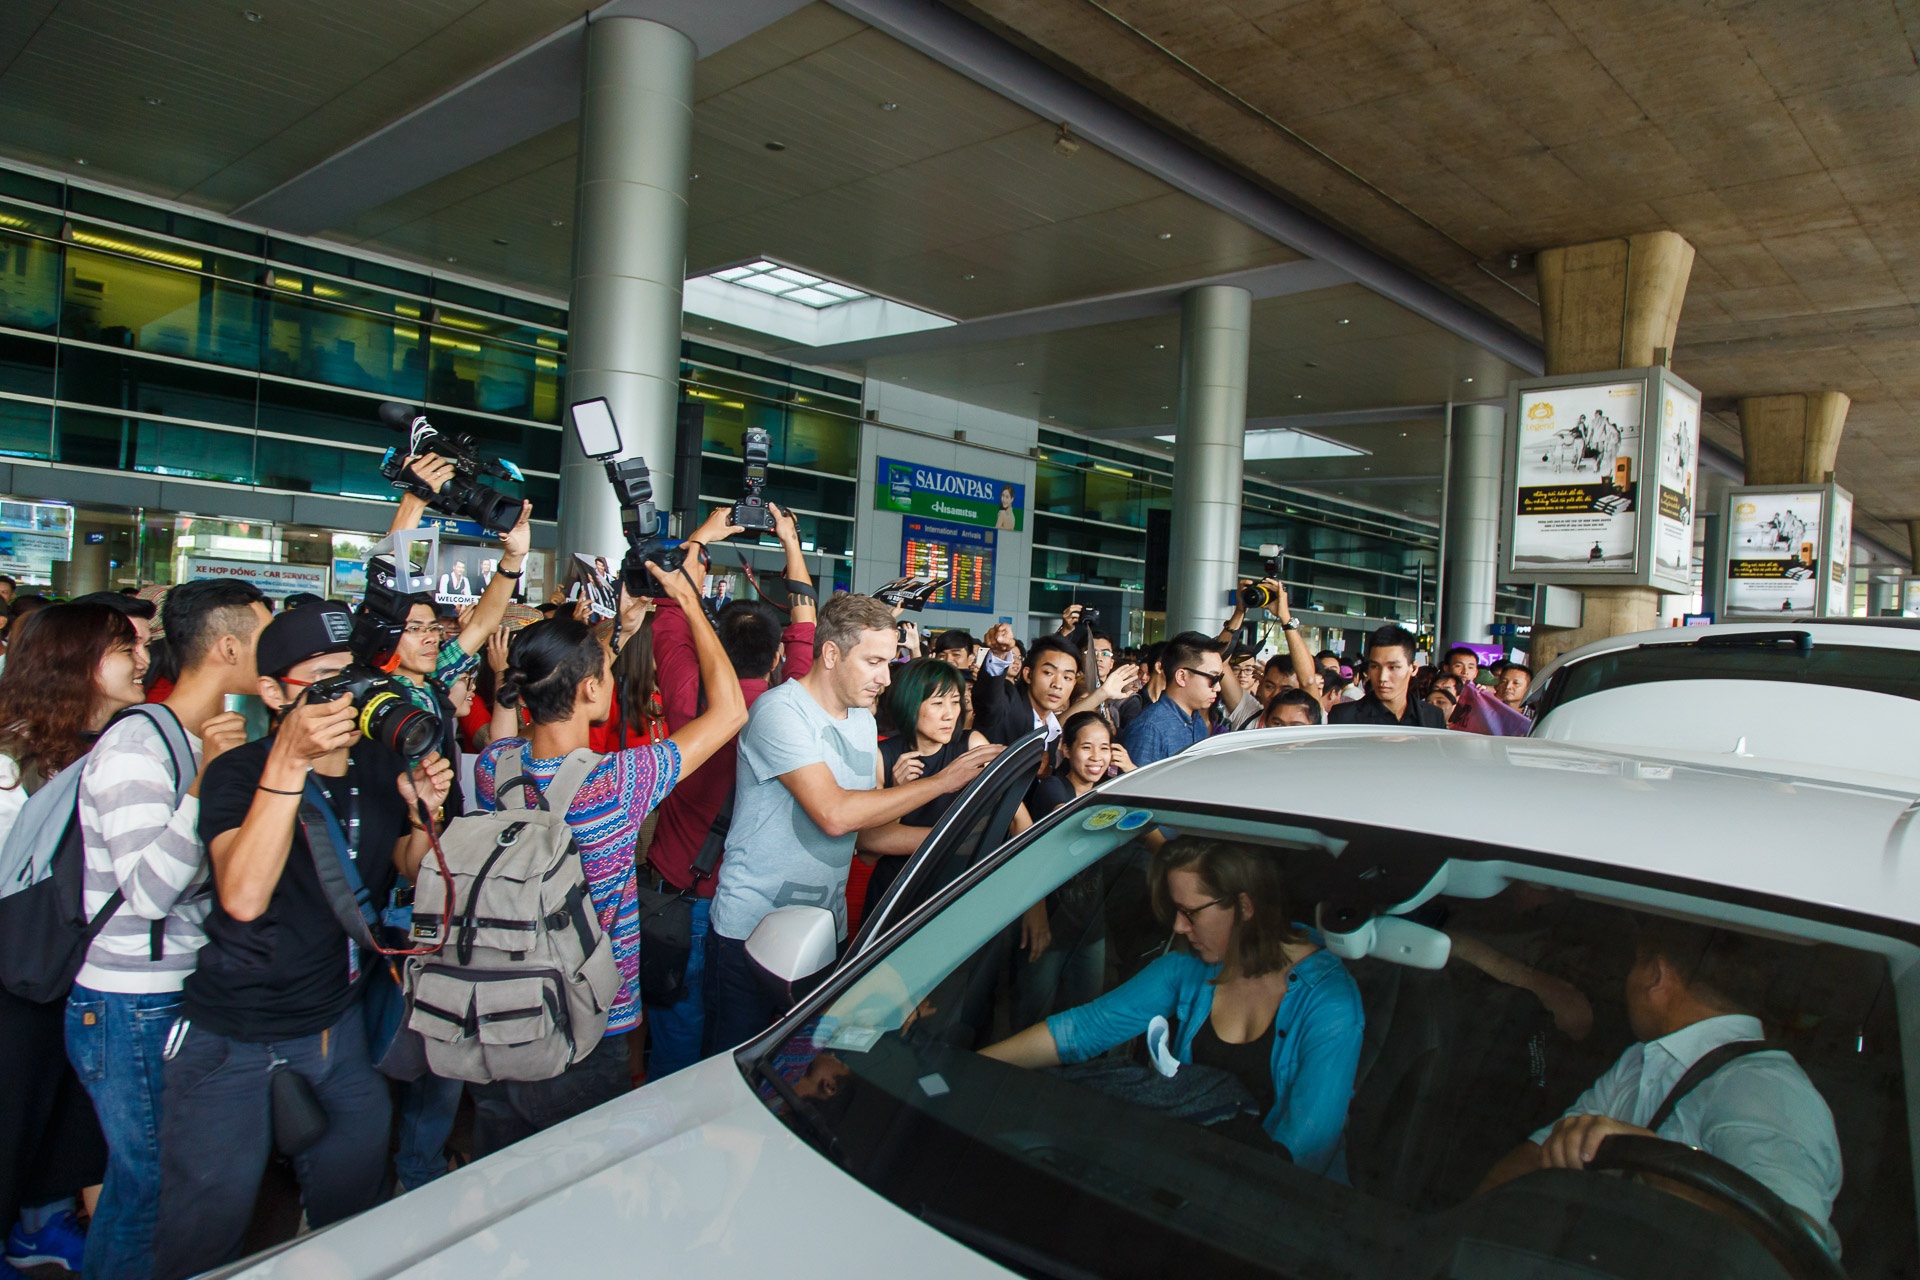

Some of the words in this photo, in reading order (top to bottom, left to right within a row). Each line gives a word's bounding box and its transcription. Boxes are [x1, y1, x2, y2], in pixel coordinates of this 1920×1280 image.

[1526, 421, 1555, 432] Legend
[915, 469, 993, 500] SALONPAS
[924, 524, 958, 536] International
[961, 530, 982, 540] Arrivals
[196, 565, 207, 573] XE
[263, 570, 281, 578] CAR
[282, 572, 320, 581] SERVICES
